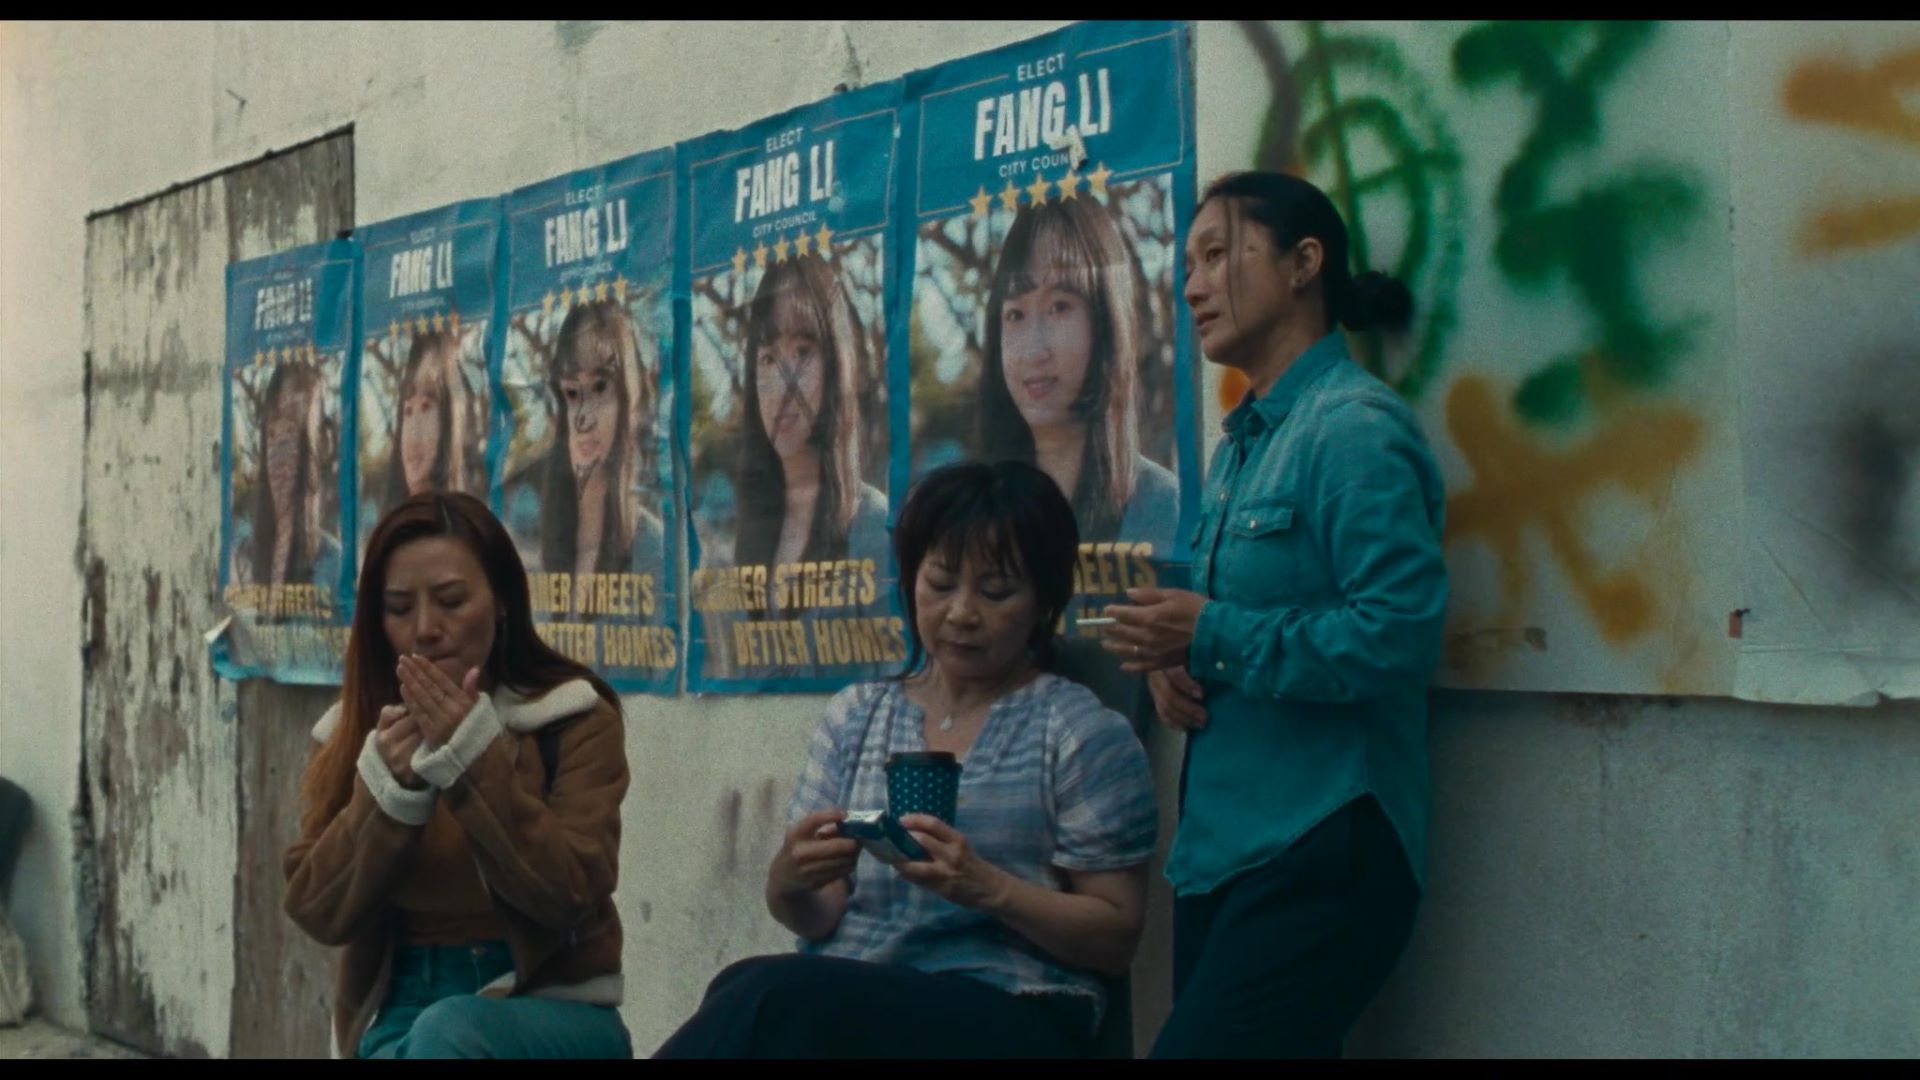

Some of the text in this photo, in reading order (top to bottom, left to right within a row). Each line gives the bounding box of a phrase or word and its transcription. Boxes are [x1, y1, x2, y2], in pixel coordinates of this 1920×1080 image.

[1017, 53, 1065, 82] ELECT
[974, 68, 1111, 161] FANG LI
[766, 127, 803, 153] ELECT
[735, 139, 834, 224] FANG LI
[999, 152, 1070, 178] CITY COUN
[565, 184, 603, 206] ELECT
[545, 198, 627, 268] FANG LI
[753, 210, 817, 239] CITY COUNCIL
[390, 240, 453, 299] FANG LI
[774, 558, 876, 609] STREETS
[1073, 541, 1156, 594] EETS
[576, 572, 654, 616] STREETS
[603, 624, 677, 669] HOMES
[813, 616, 906, 666] HOMES
